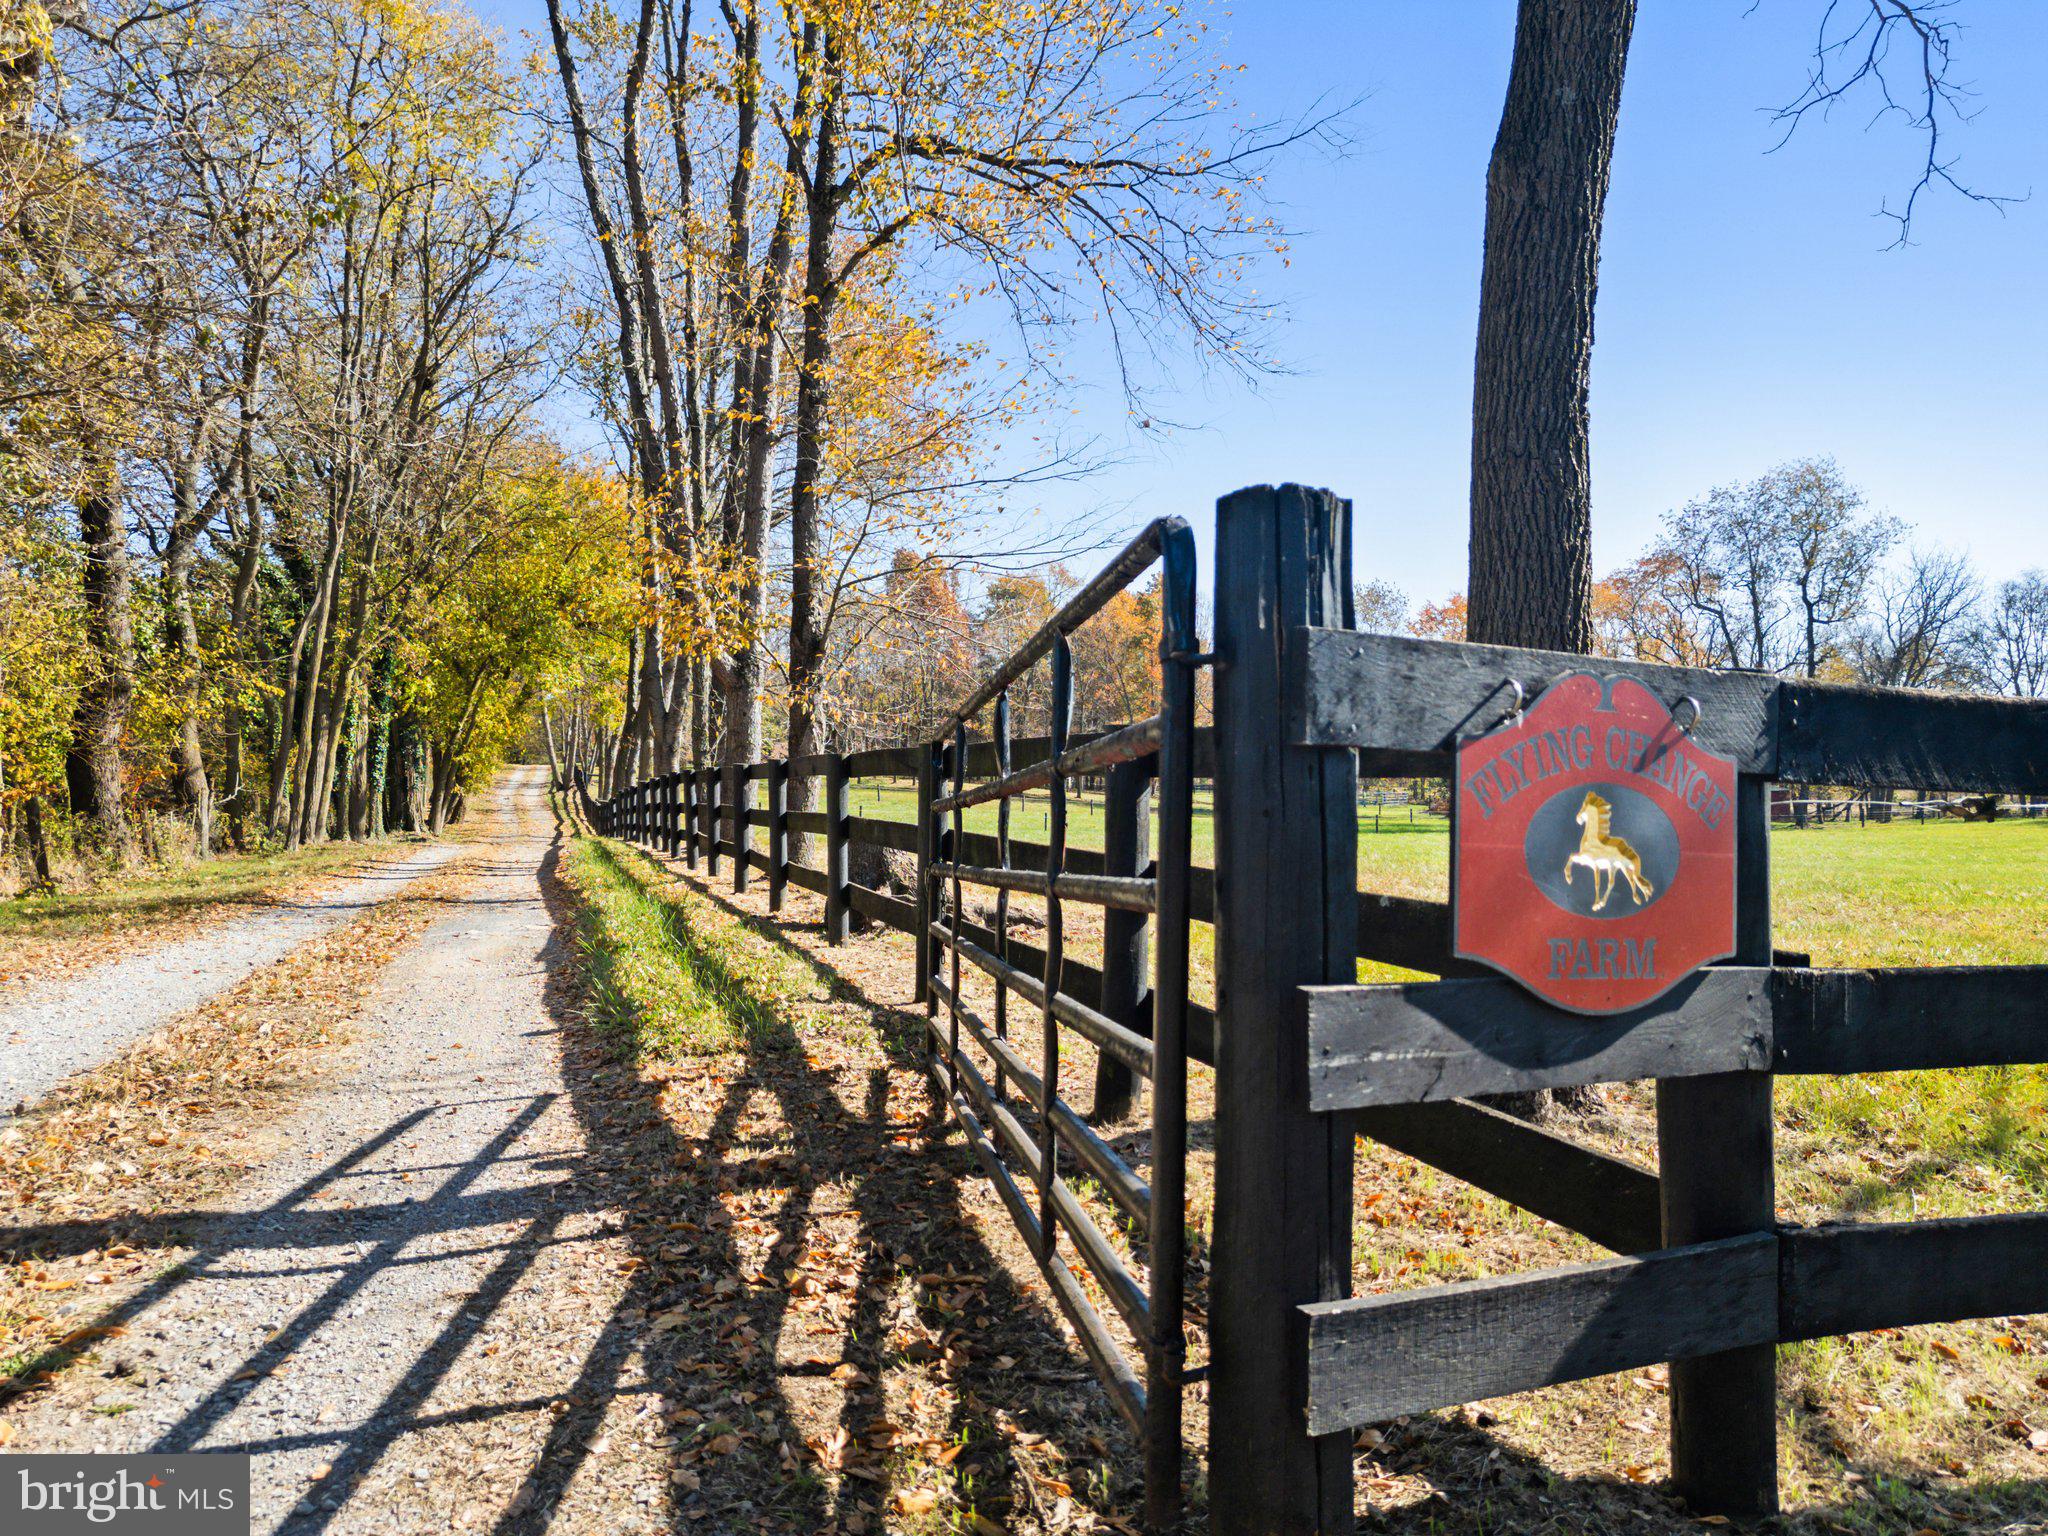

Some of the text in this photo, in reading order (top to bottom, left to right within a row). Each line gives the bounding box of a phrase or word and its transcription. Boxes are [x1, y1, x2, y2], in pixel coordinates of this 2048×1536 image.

[1464, 725, 1730, 831] FLYING CHANGE
[1547, 938, 1657, 980] FARM
